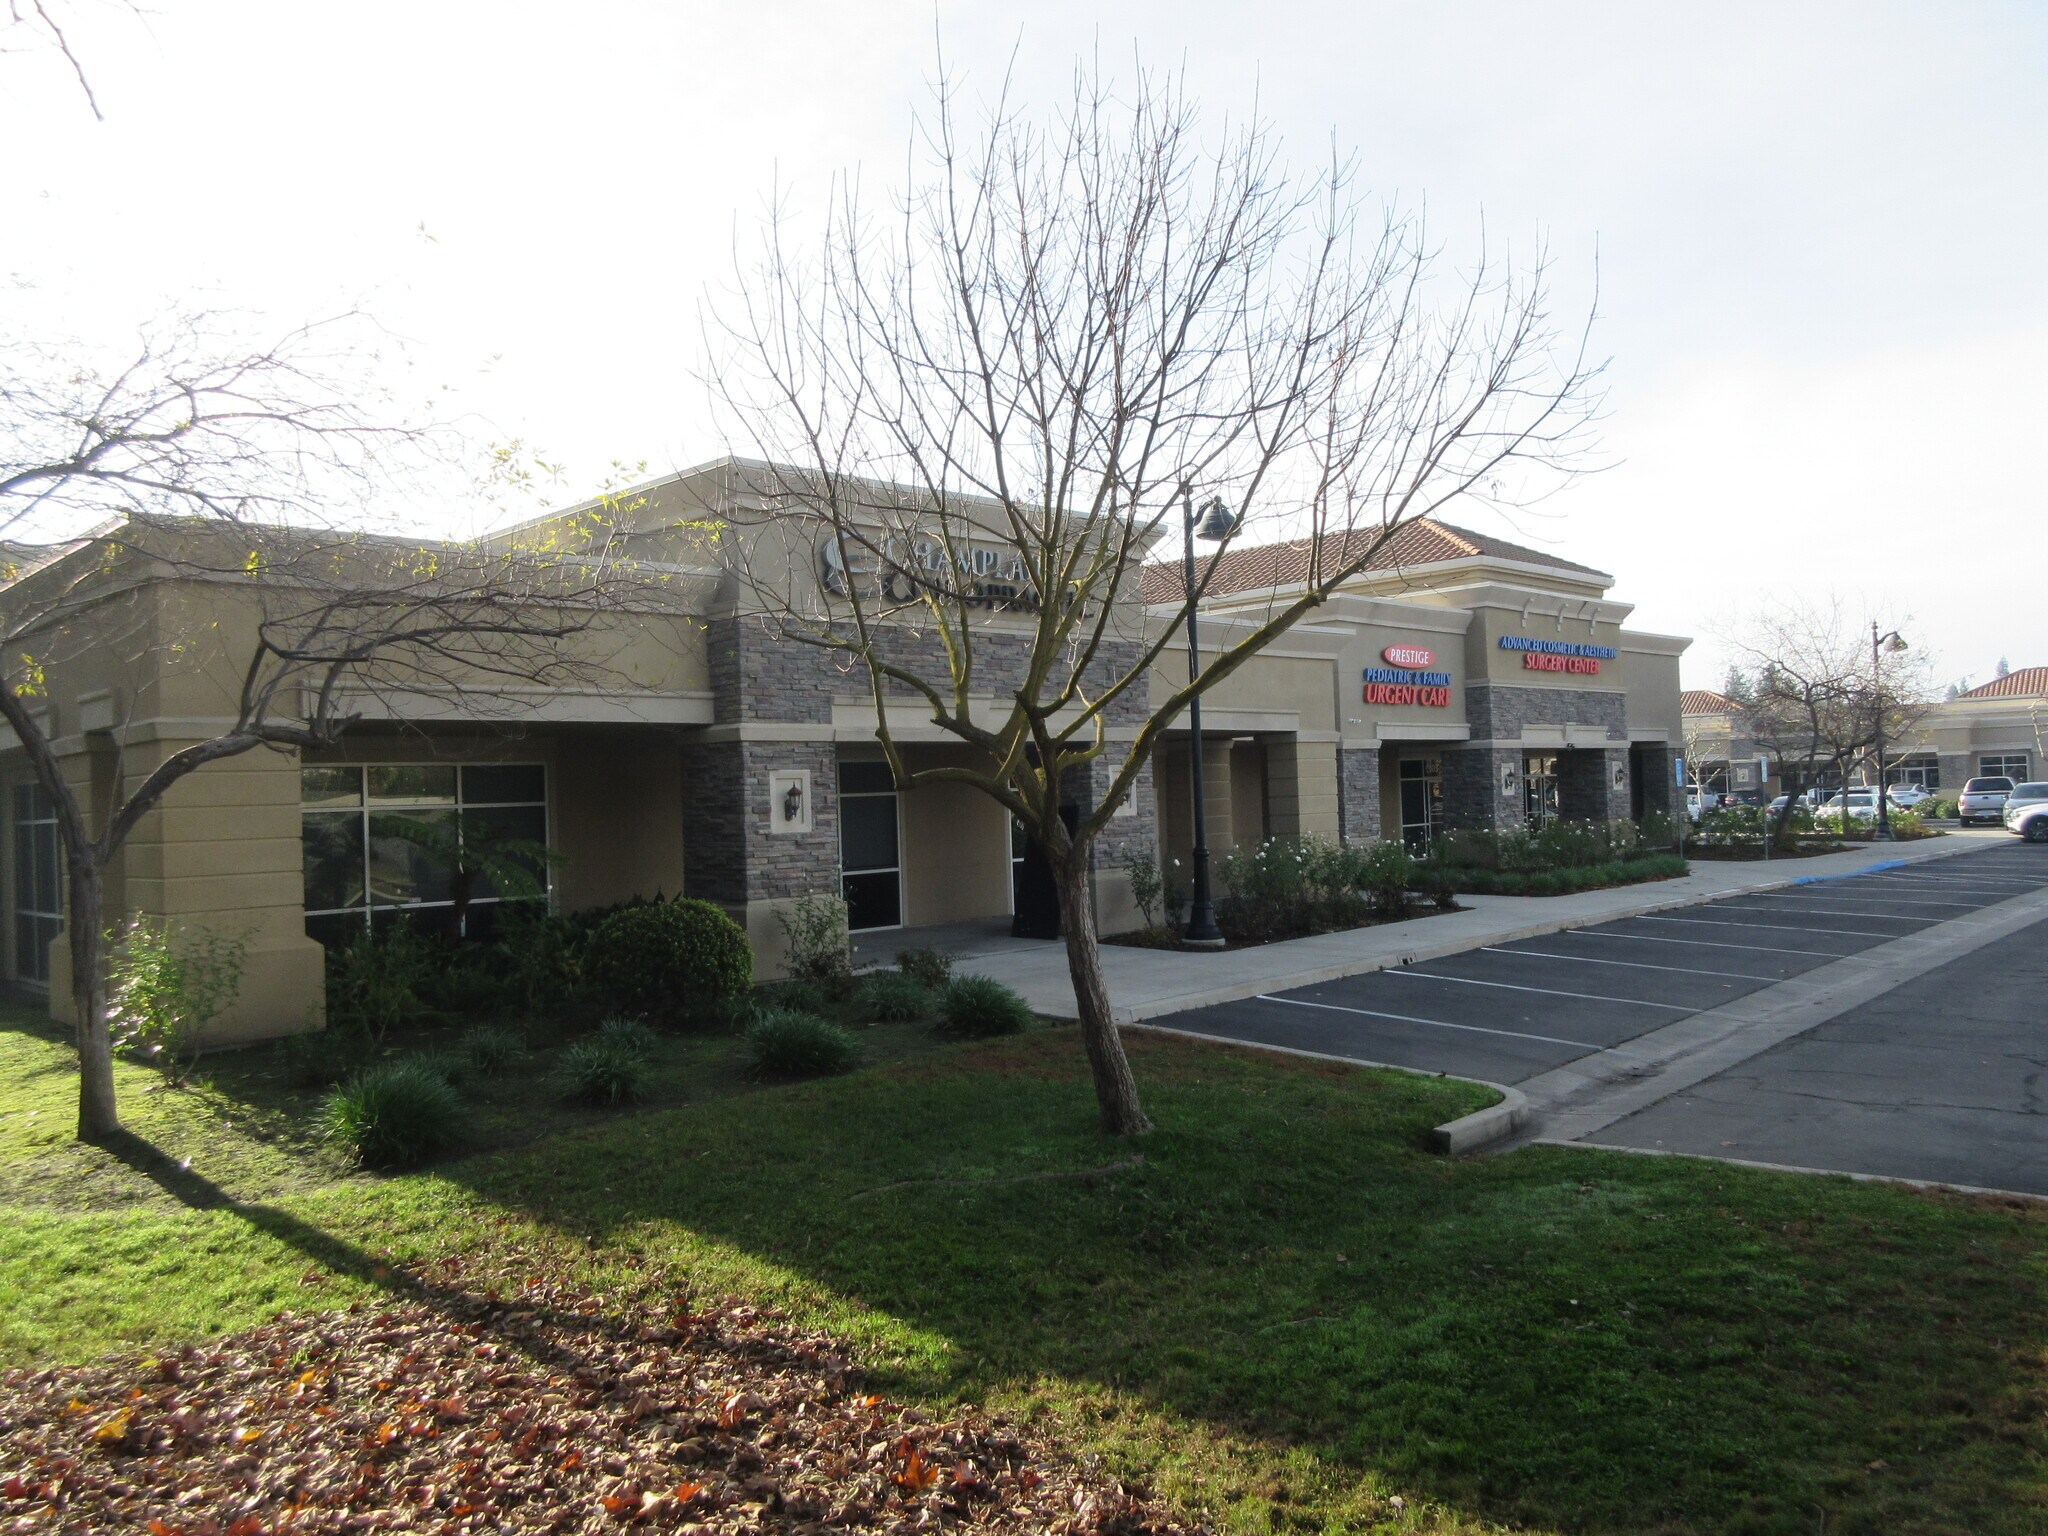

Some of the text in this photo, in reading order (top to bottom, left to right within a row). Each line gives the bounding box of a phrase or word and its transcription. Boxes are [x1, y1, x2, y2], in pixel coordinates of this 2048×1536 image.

[1390, 648, 1429, 664] PRESTIGE
[1501, 636, 1618, 659] ADVANCED COSMETIC & AESTHETIC
[1526, 653, 1601, 674] SURGERY CENTER
[1366, 668, 1452, 686] PEDIATRIC & FAMILY
[1366, 684, 1452, 707] URGENT CARE
